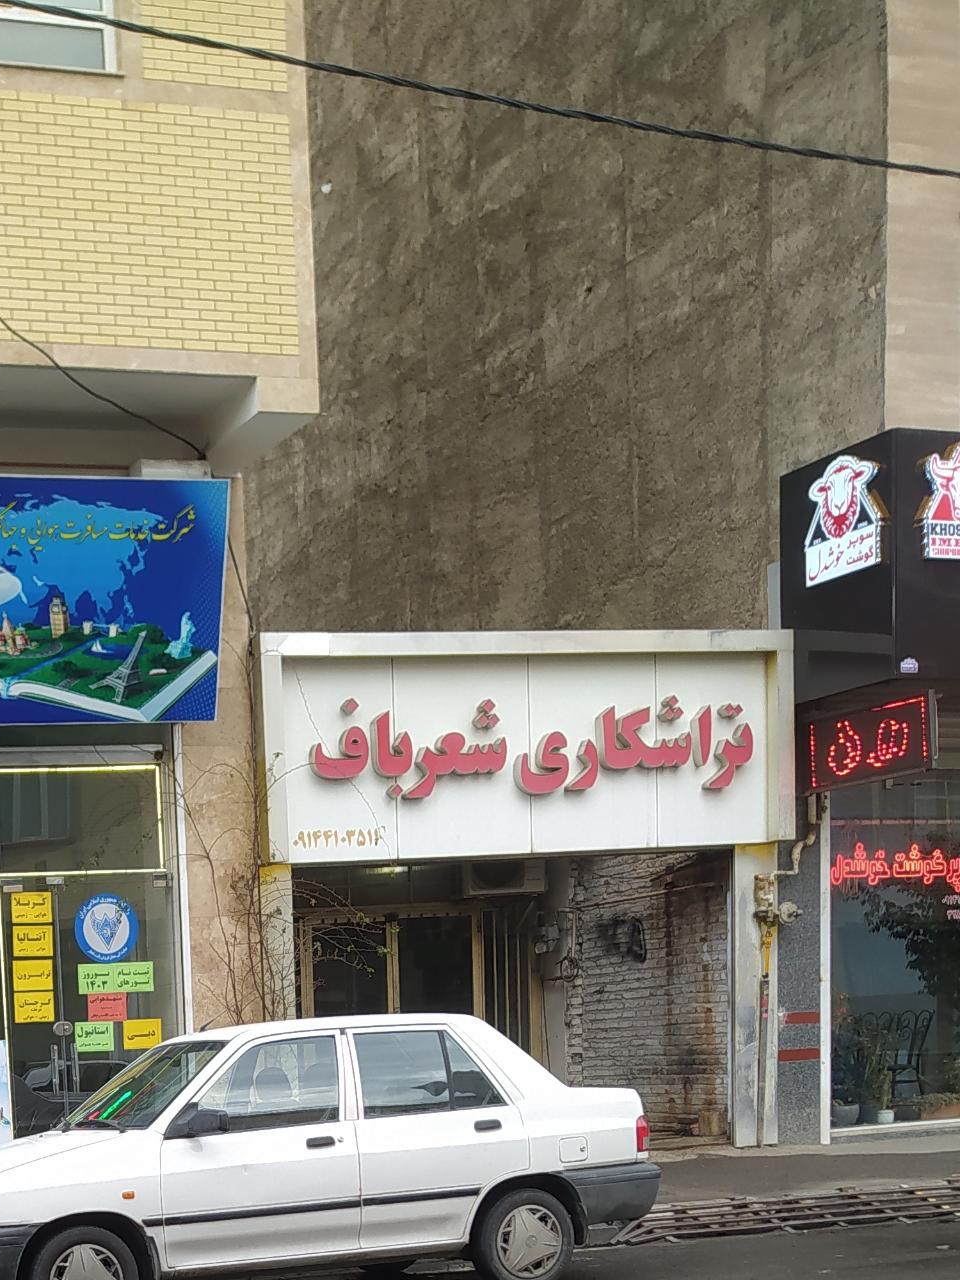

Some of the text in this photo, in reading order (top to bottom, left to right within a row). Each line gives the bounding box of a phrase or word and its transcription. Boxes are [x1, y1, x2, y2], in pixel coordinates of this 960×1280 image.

[108, 519, 150, 542] خدمات
[152, 504, 195, 543] شرکت
[847, 530, 874, 549] سوپر
[808, 543, 845, 581] خوشدل
[846, 547, 875, 566] گوشت
[309, 697, 507, 800] شعرباف
[514, 695, 754, 795] تراشکاری
[830, 842, 891, 885] خوشدل
[893, 843, 947, 885] گوشت
[13, 896, 48, 909] کربلا
[16, 930, 47, 944] آنتالیا
[16, 968, 51, 981] ترابزون
[82, 971, 110, 980] نوروز
[117, 966, 150, 977] ثبت نام
[85, 981, 108, 991] ۱۴۰۳
[116, 977, 150, 988] تورهای
[77, 1025, 109, 1039] استانبول
[126, 1029, 156, 1041] دبی
